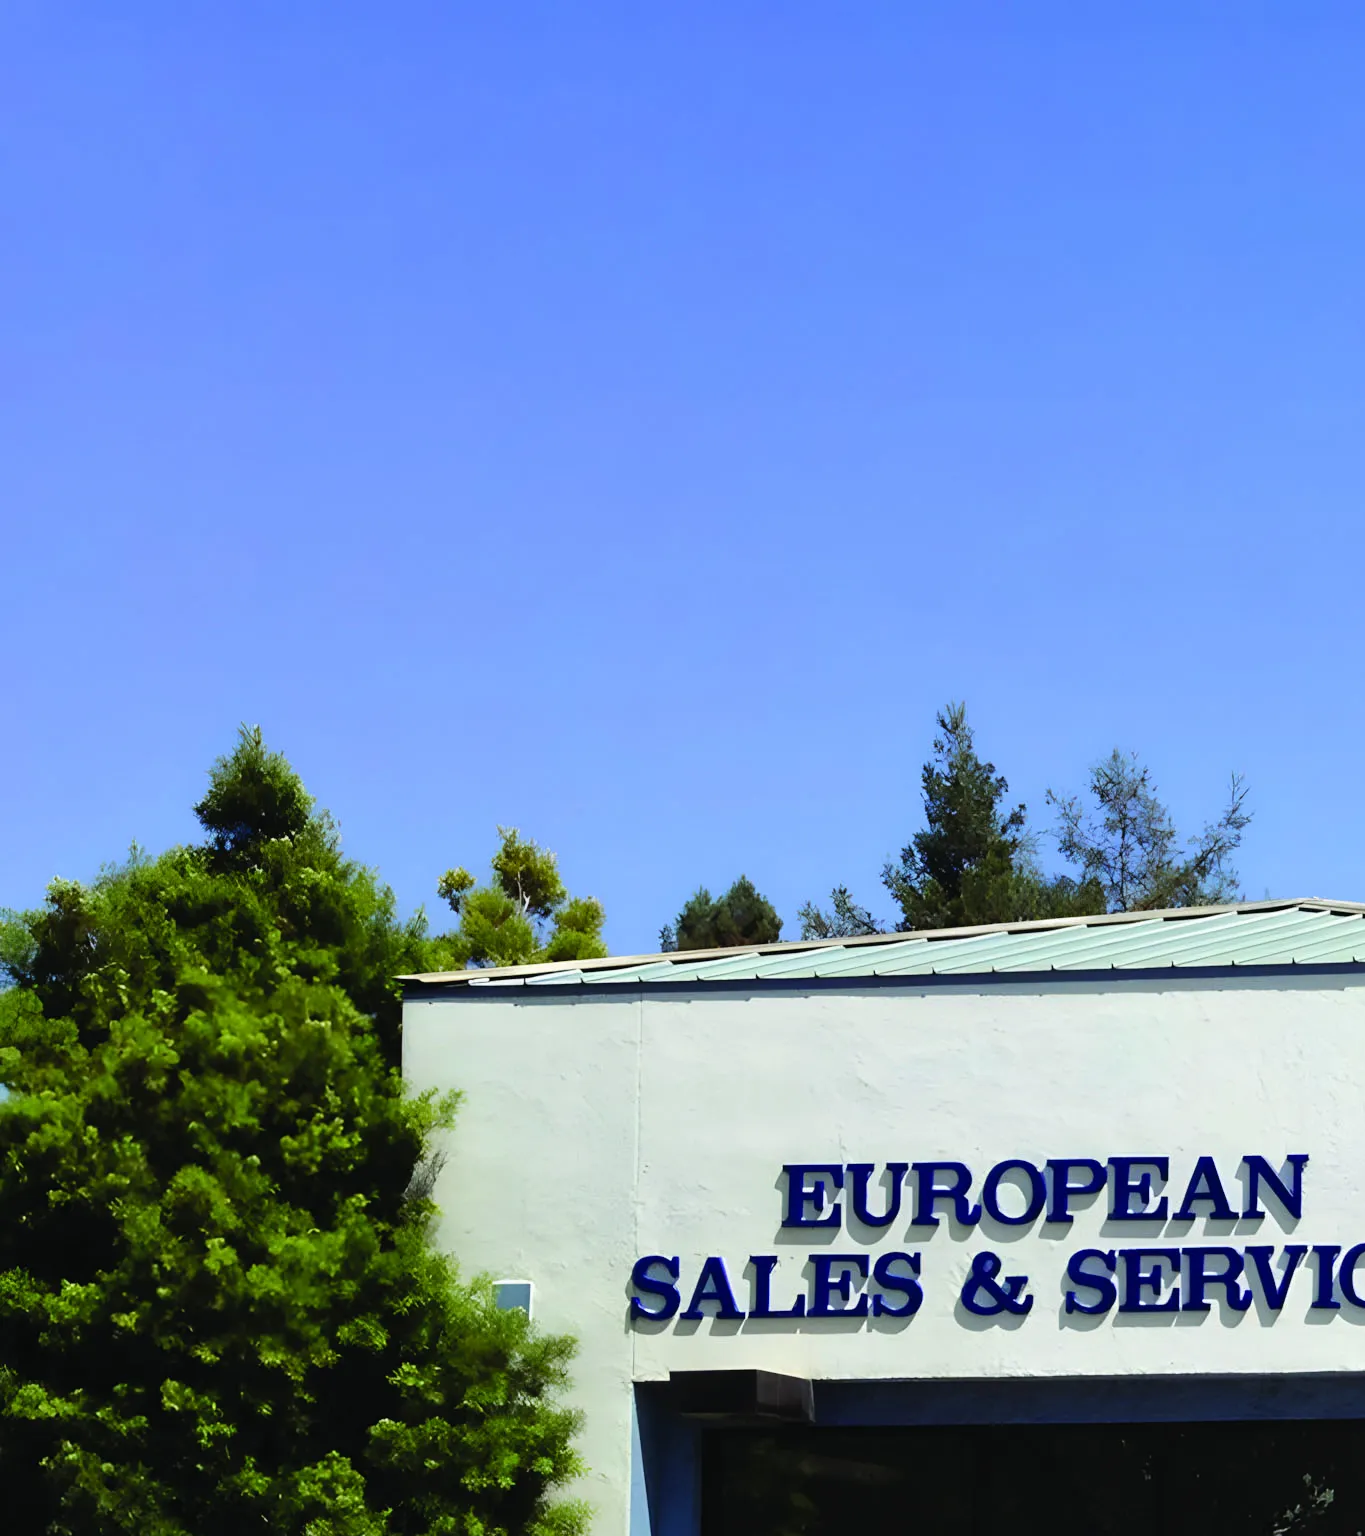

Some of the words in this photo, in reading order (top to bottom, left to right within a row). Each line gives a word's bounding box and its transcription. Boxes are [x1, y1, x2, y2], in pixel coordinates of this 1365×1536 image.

[781, 1154, 1310, 1229] EUROPEAN
[629, 1251, 924, 1321] SALES
[960, 1250, 1034, 1315] &
